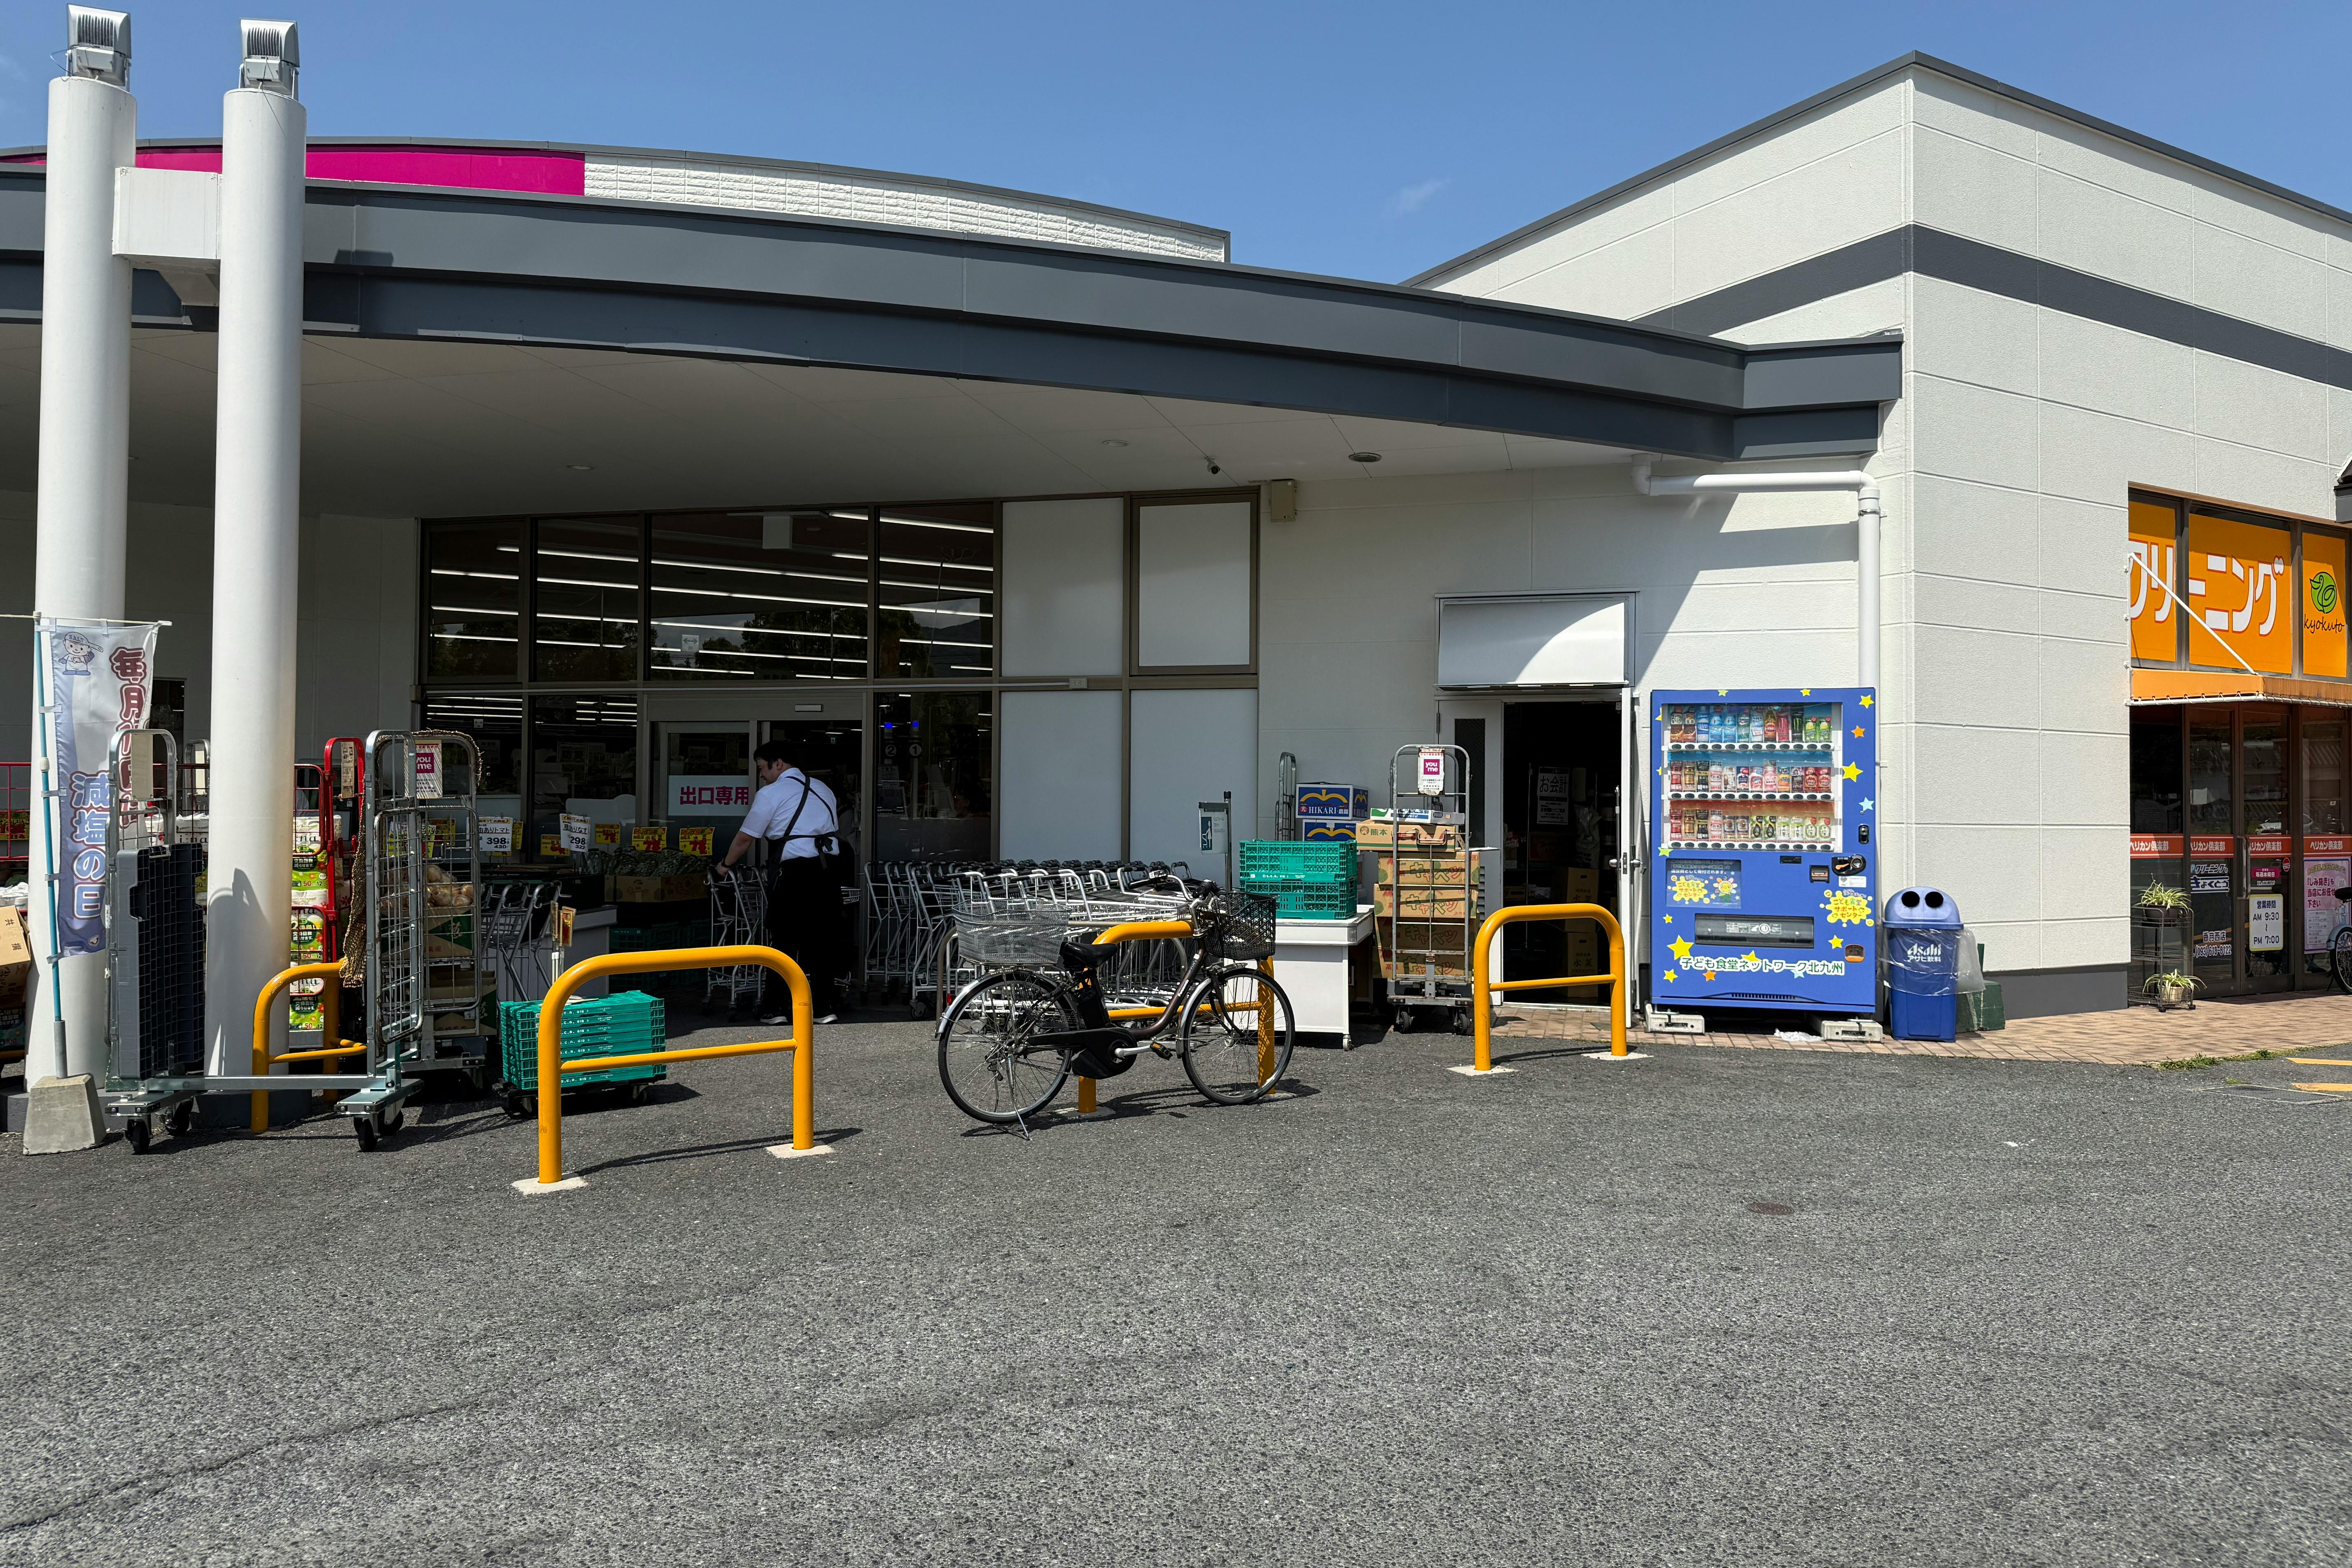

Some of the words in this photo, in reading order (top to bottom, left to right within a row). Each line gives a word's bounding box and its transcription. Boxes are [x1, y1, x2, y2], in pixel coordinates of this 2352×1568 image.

[2304, 614, 2345, 634] kyokuto
[1539, 775, 1568, 793] お会計
[680, 786, 749, 805] 出口専用
[570, 836, 586, 845] 298
[2310, 840, 2343, 850] ペリカン倶楽部
[1409, 861, 1463, 882] キャベツ
[2307, 888, 2336, 897] 当店にお任せ
[1405, 894, 1458, 915] キャベツ
[1833, 898, 1862, 906] こども食堂
[2256, 900, 2276, 909] 営業時間
[2307, 899, 2321, 908] 下さい
[2253, 913, 2262, 921] AM
[2264, 912, 2280, 921] 9:30
[1405, 924, 1458, 945] キャベツ
[2202, 930, 2226, 943] 香月西店
[2254, 936, 2262, 945] PM
[2265, 935, 2280, 944] 7:00
[1907, 943, 1941, 956] Asahi
[1573, 958, 1593, 967] 水菜
[1681, 957, 1843, 974] 子ども食堂ネットワーク北九州
